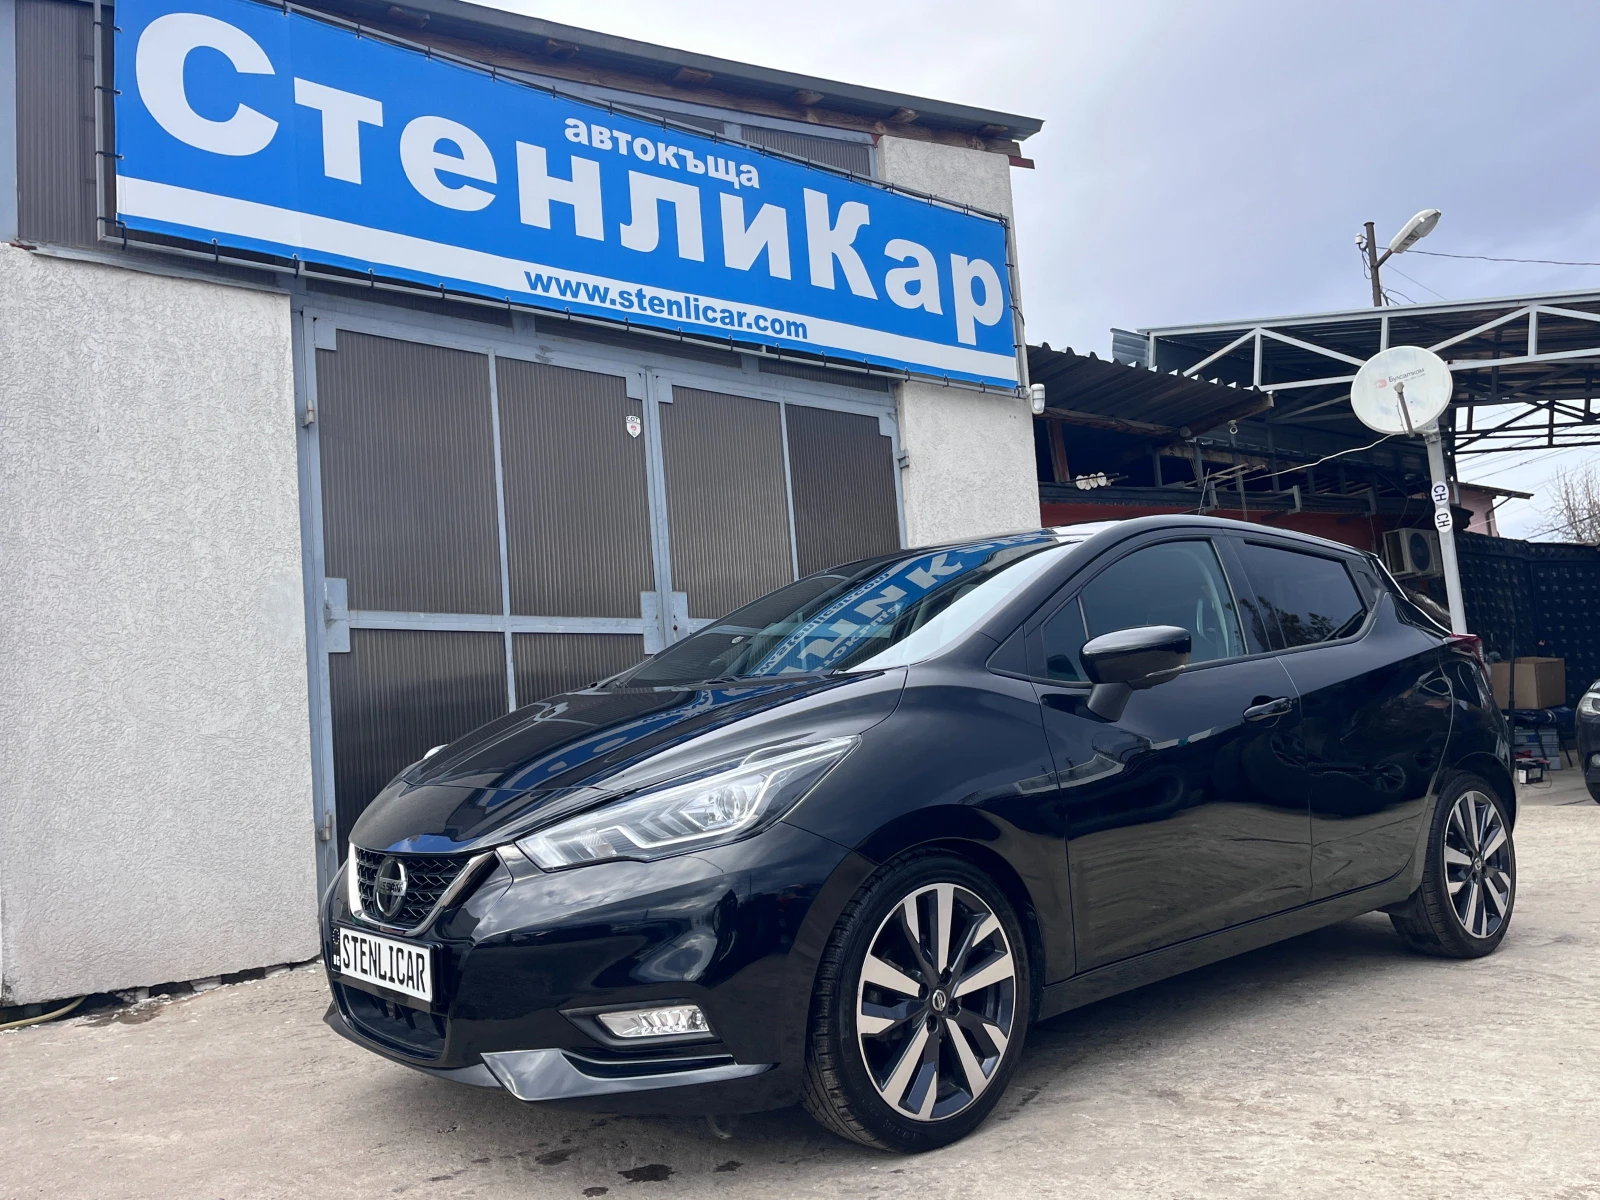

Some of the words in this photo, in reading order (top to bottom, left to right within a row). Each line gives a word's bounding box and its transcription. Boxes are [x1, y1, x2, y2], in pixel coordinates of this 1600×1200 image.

[135, 12, 1004, 346] СтенлиКар
[564, 117, 760, 189] автокъща
[524, 271, 808, 340] www.stenlicar.com
[1433, 484, 1447, 502] CH
[1436, 512, 1451, 528] CH
[343, 934, 426, 993] STENLICAR
